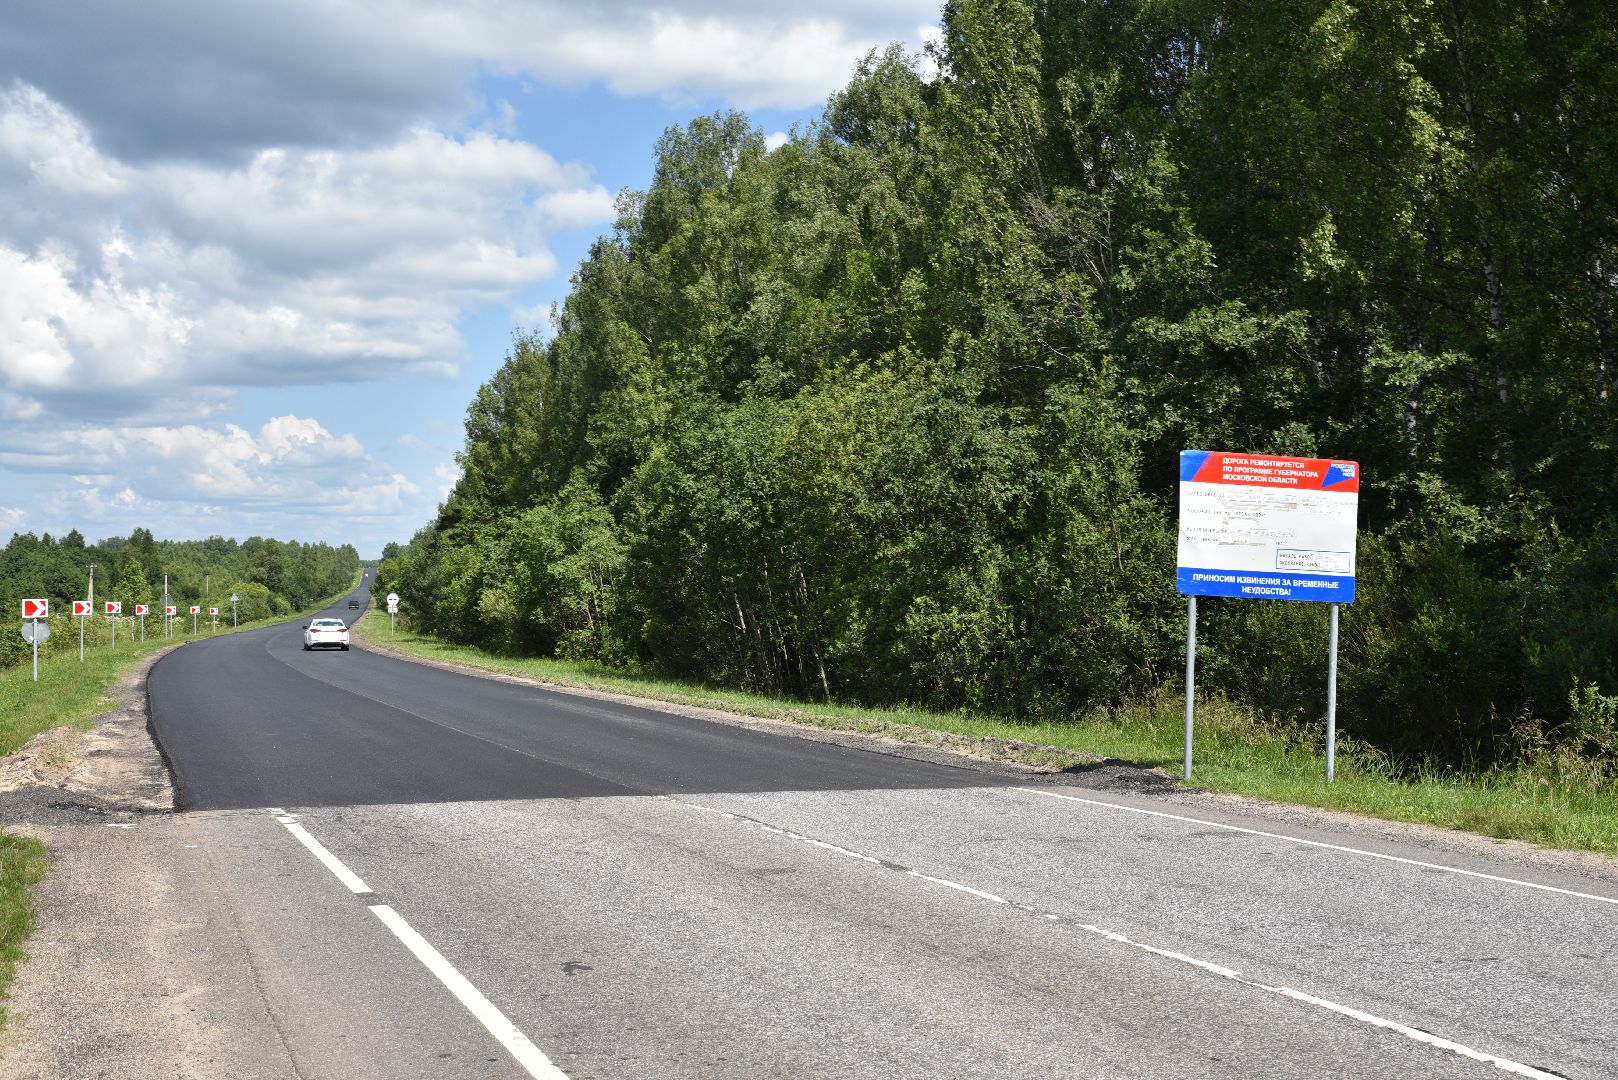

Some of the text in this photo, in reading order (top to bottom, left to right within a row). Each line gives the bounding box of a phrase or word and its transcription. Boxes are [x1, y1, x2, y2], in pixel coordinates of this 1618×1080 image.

[1250, 459, 1304, 469] РЕМОНТИРУЕТСЯ
[1274, 469, 1318, 478] ГУБЕРНАТОРА
[1193, 574, 1235, 582] ПРИНОСИМ
[1237, 576, 1280, 585] ИЗВИНЕНИЯ
[1293, 579, 1339, 588] ВРЕМЕННЫЕ
[1242, 586, 1291, 595] НЕУДОБСТВА!
